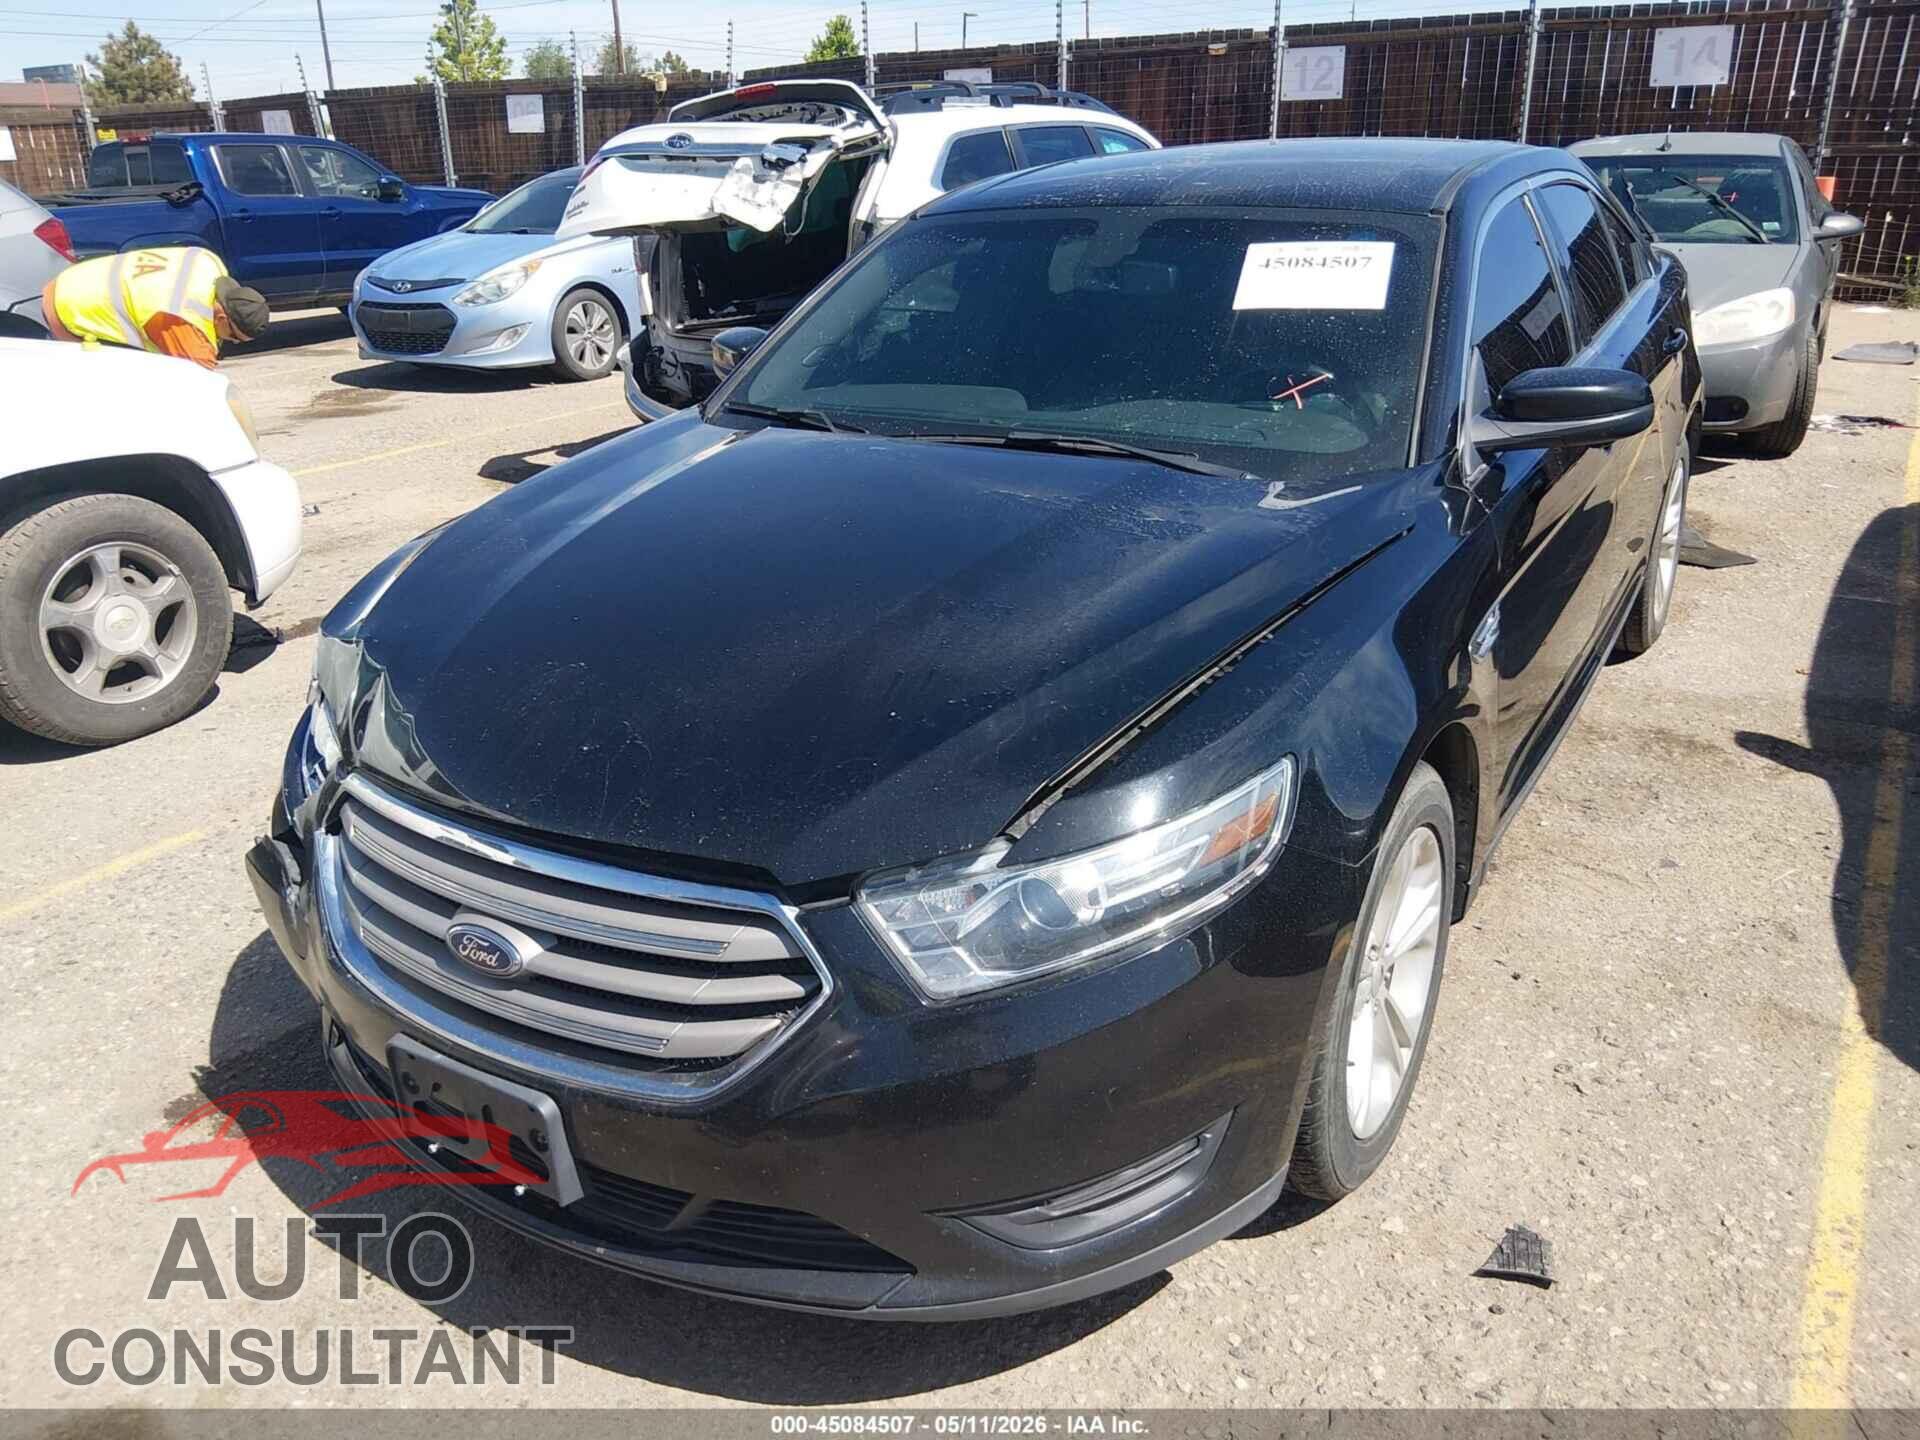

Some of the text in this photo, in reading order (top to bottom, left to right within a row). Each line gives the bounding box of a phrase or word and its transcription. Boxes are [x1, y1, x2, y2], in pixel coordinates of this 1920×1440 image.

[1294, 55, 1334, 91] 12
[1257, 255, 1373, 270] 45084507
[459, 934, 501, 967] Ford
